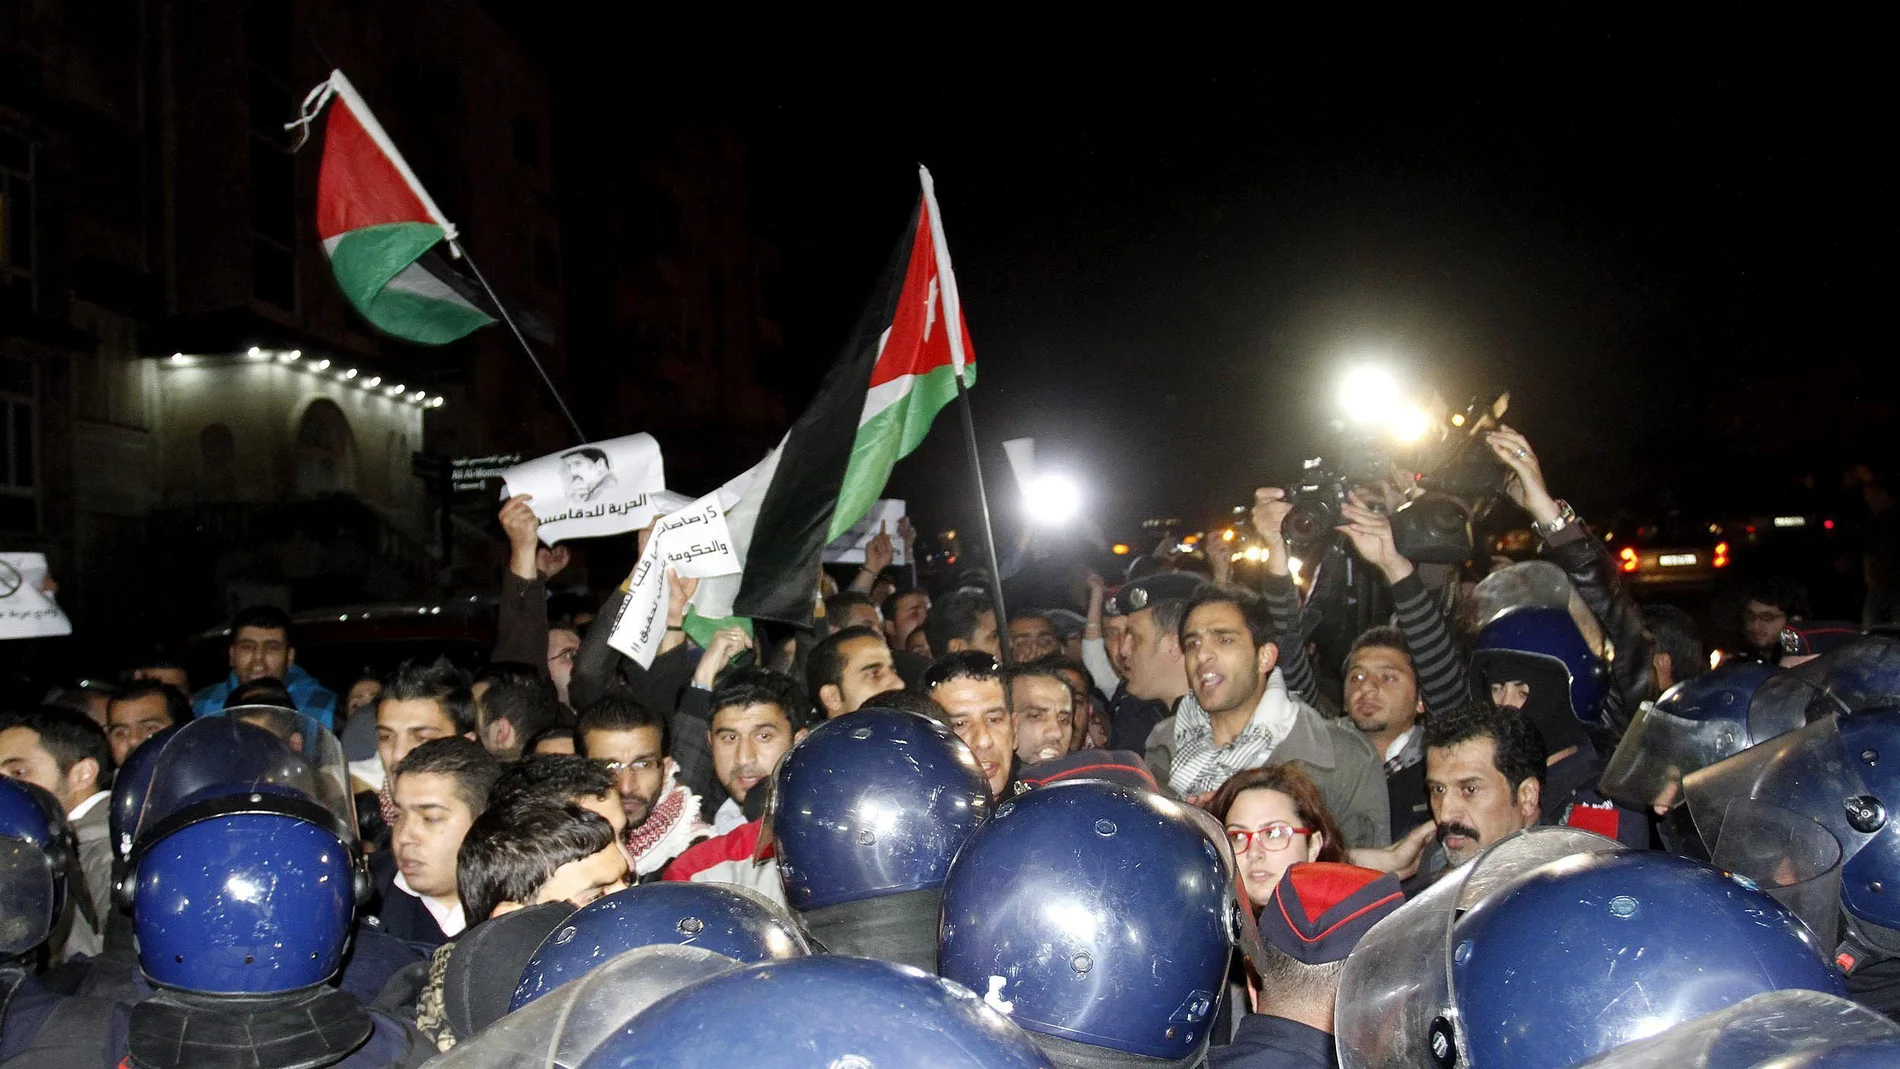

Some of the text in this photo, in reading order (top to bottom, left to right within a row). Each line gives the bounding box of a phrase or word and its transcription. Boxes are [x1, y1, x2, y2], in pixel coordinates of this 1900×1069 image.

[609, 493, 647, 516] الحرية
[706, 505, 718, 519] 5
[667, 540, 729, 563] والحكومة
[632, 559, 652, 587] قلب
